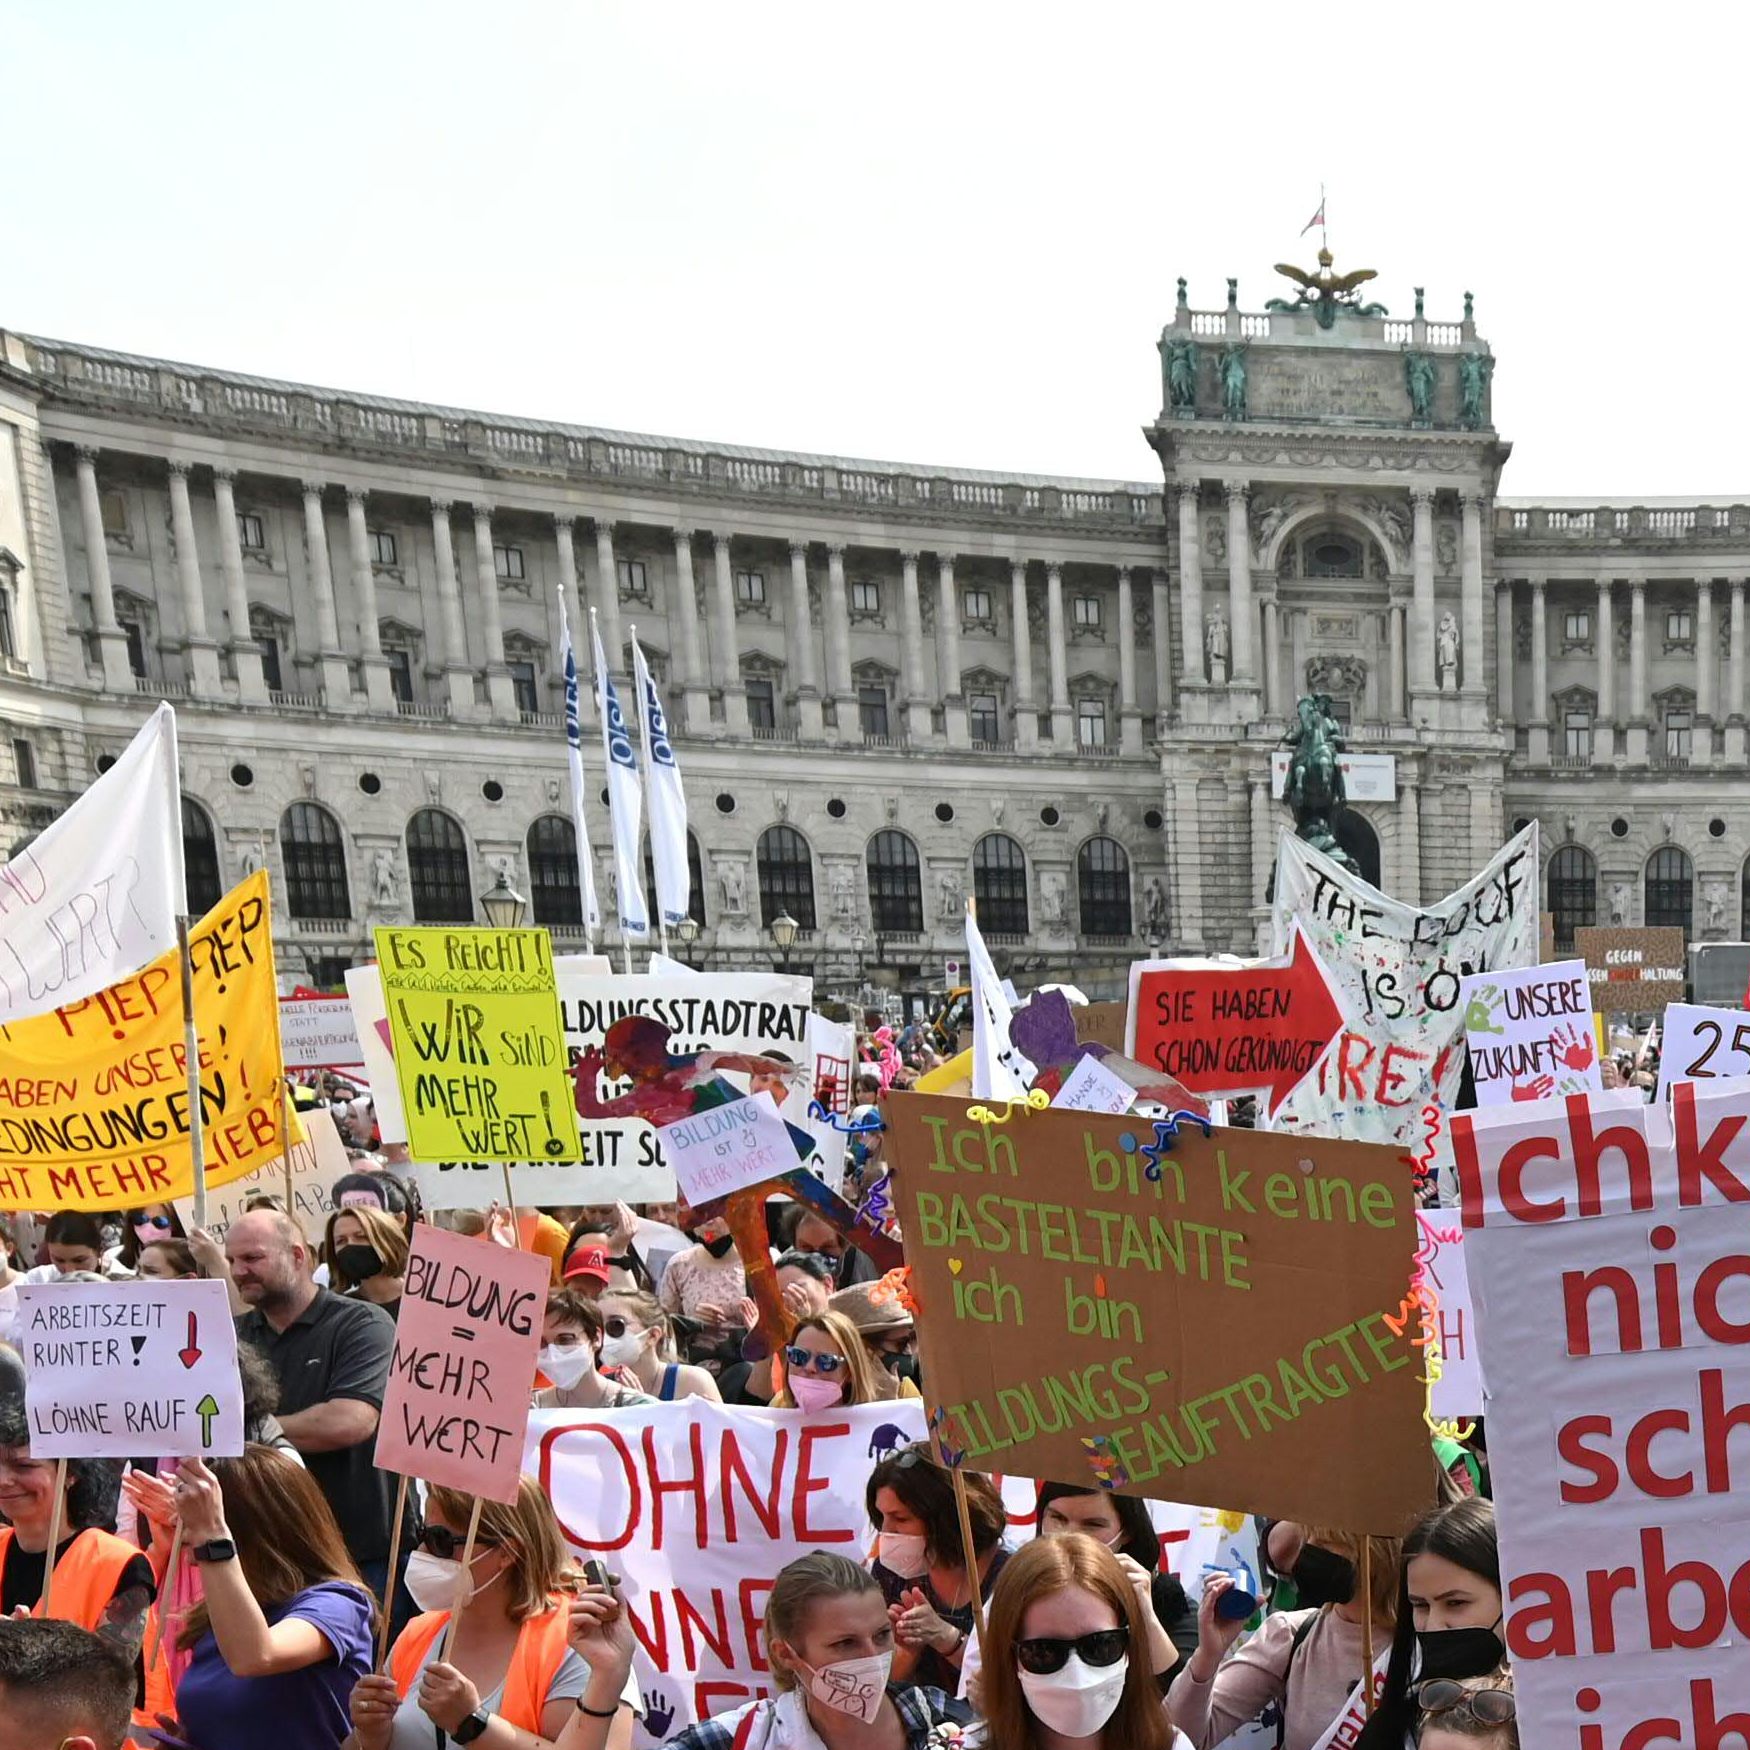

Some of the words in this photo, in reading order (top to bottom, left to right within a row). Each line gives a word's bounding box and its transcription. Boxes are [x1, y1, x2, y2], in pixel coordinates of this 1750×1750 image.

[1306, 862, 1384, 939] THE
[1605, 950, 1642, 964] GEGEN
[1157, 991, 1194, 1026] SIE
[1212, 988, 1291, 1021] HABEN
[1361, 969, 1405, 1019] IS
[1504, 979, 1586, 1021] UNSERE
[1224, 1032, 1326, 1074] GEKÜNDIGT
[1472, 1040, 1558, 1082] ZUKUNFT
[415, 1074, 500, 1119] MEHR
[668, 1102, 759, 1151] BILDUNG
[714, 1142, 733, 1156] IST
[47, 1154, 172, 1201] MEHR
[203, 1108, 276, 1172] LIEB
[690, 1165, 731, 1192] MEHR
[739, 1145, 776, 1178] WERT
[921, 1115, 1018, 1177] Ich
[1083, 1131, 1186, 1204] bin
[1217, 1150, 1398, 1229] keine
[1449, 1093, 1654, 1229] Ich
[916, 1192, 1252, 1291] BASTELTANTE
[31, 1303, 167, 1331] ARBEITSZEIT
[404, 1255, 536, 1336] BILDUNG
[948, 1256, 1024, 1327] ich
[1064, 1275, 1144, 1344] bin
[36, 1402, 113, 1436] LÖHNE
[125, 1399, 187, 1434] RAUF
[538, 1422, 855, 1551] OHNE
